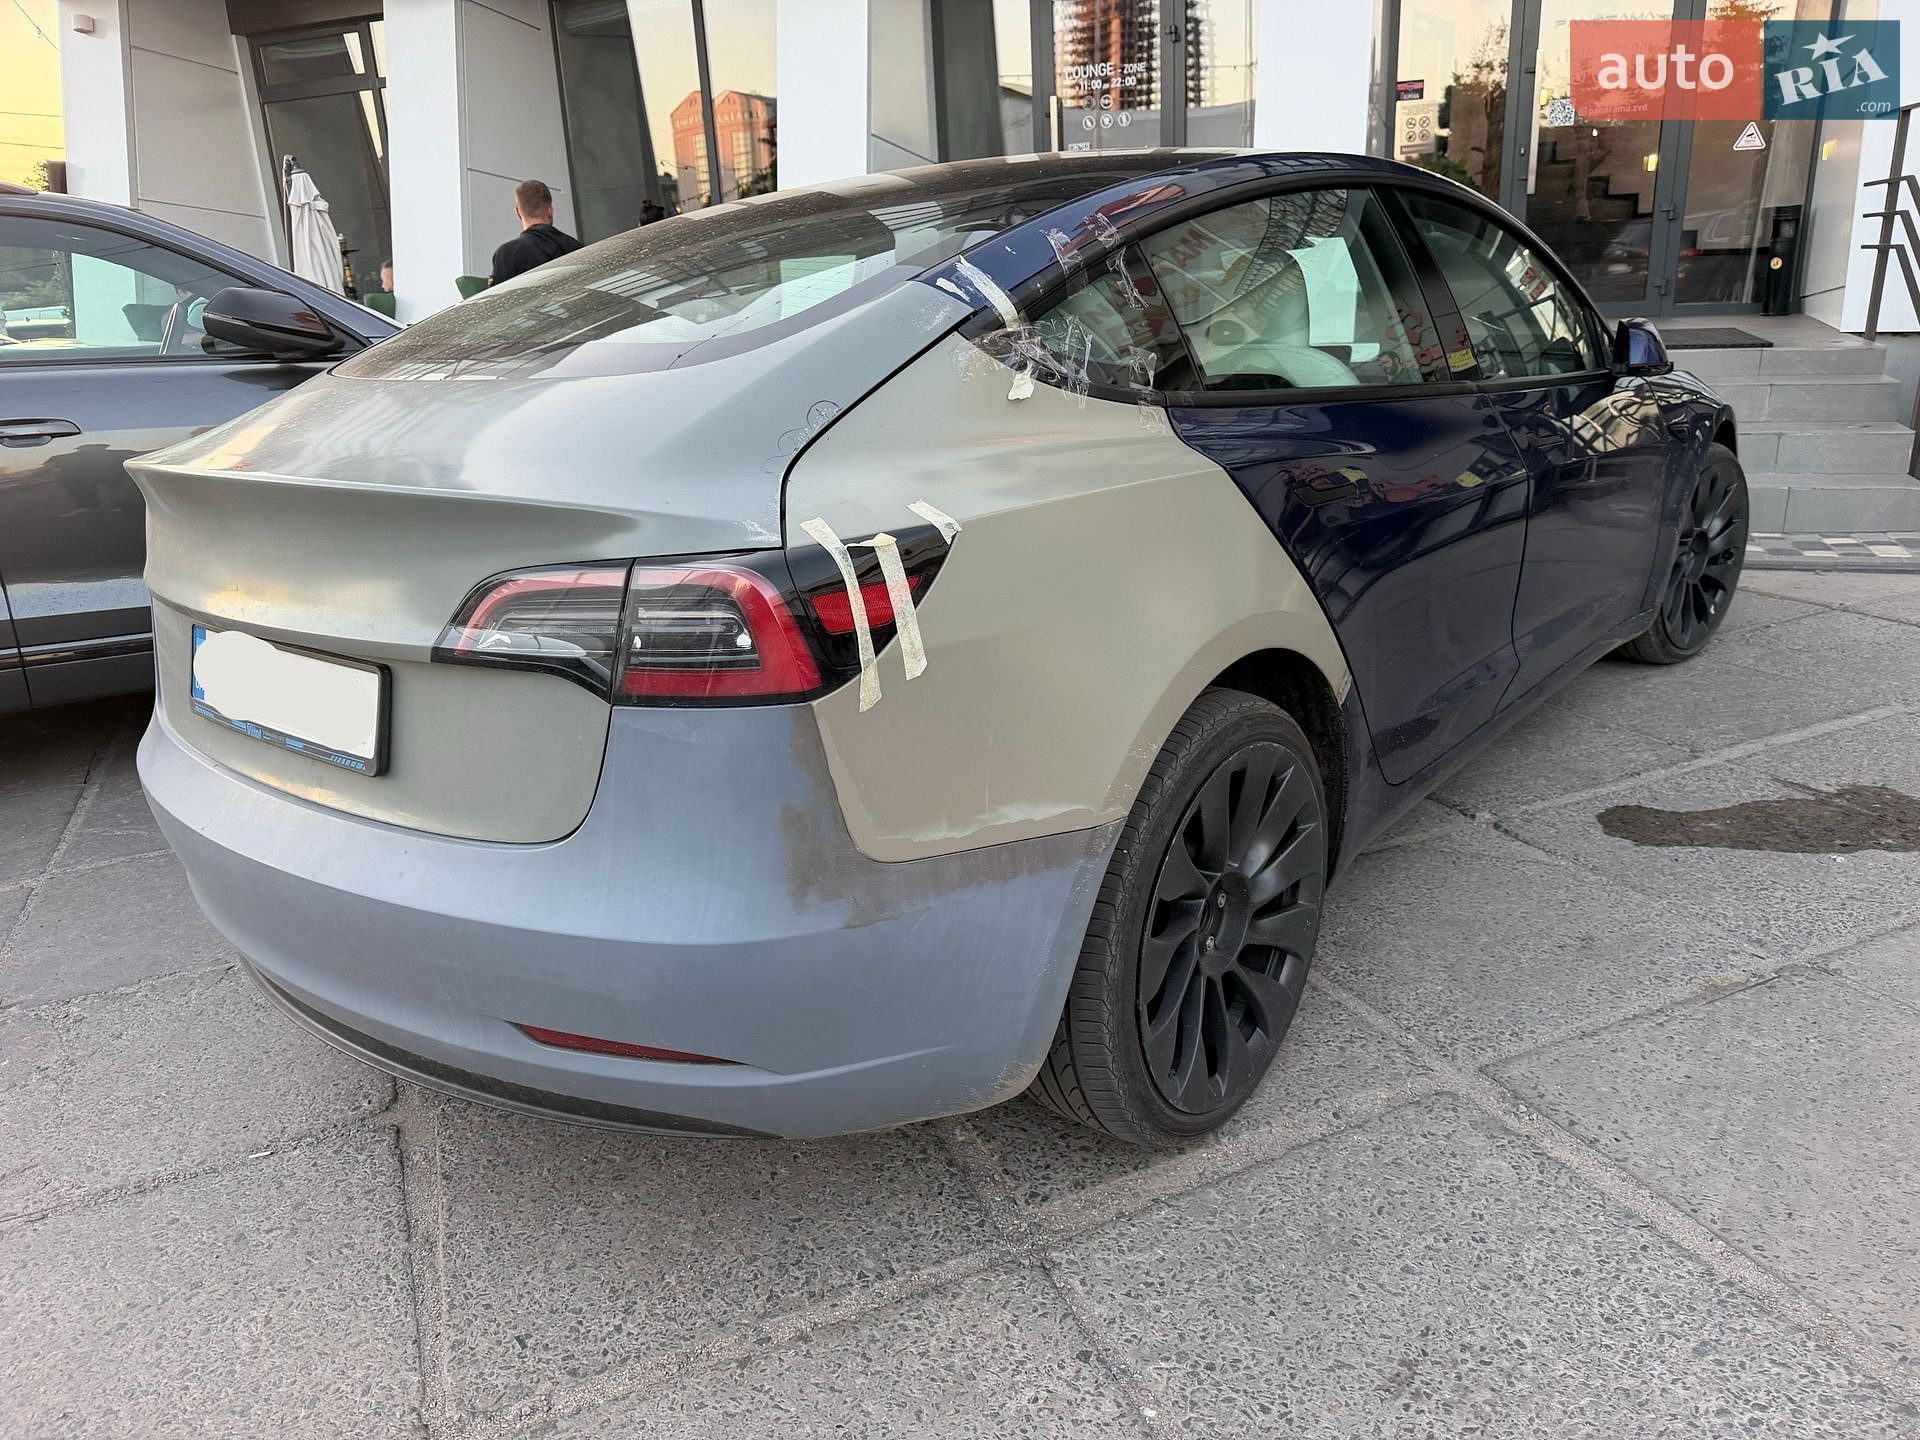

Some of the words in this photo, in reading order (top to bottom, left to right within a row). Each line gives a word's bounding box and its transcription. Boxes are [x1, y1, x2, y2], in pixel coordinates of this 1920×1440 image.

[1065, 62, 1115, 80] LOUNGE
[1123, 61, 1147, 74] ZONE
[1079, 79, 1102, 90] 11:00
[1110, 76, 1137, 88] 22:00
